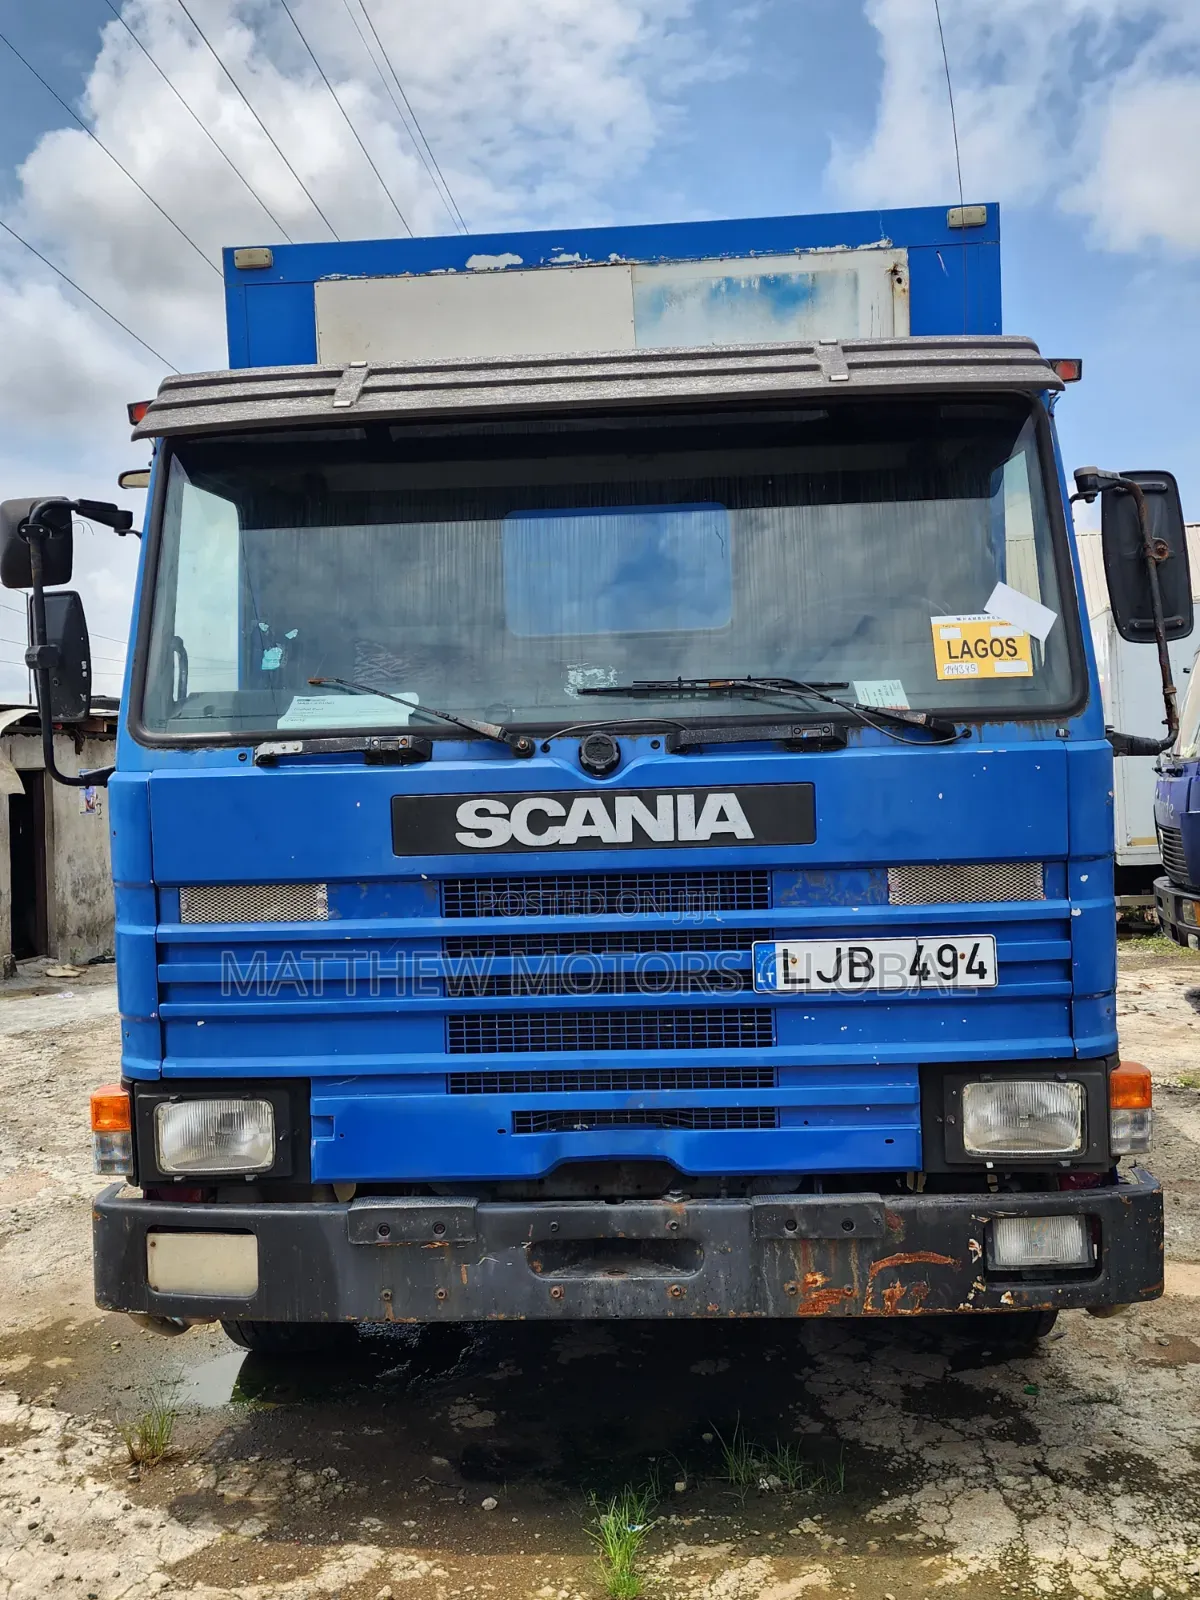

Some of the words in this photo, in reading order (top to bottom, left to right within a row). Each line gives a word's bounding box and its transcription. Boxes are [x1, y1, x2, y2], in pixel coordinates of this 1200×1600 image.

[947, 638, 1018, 660] LAGOS
[455, 793, 755, 848] SCANIA
[757, 971, 774, 984] LT
[783, 946, 875, 985] LJB
[910, 942, 987, 980] 494
